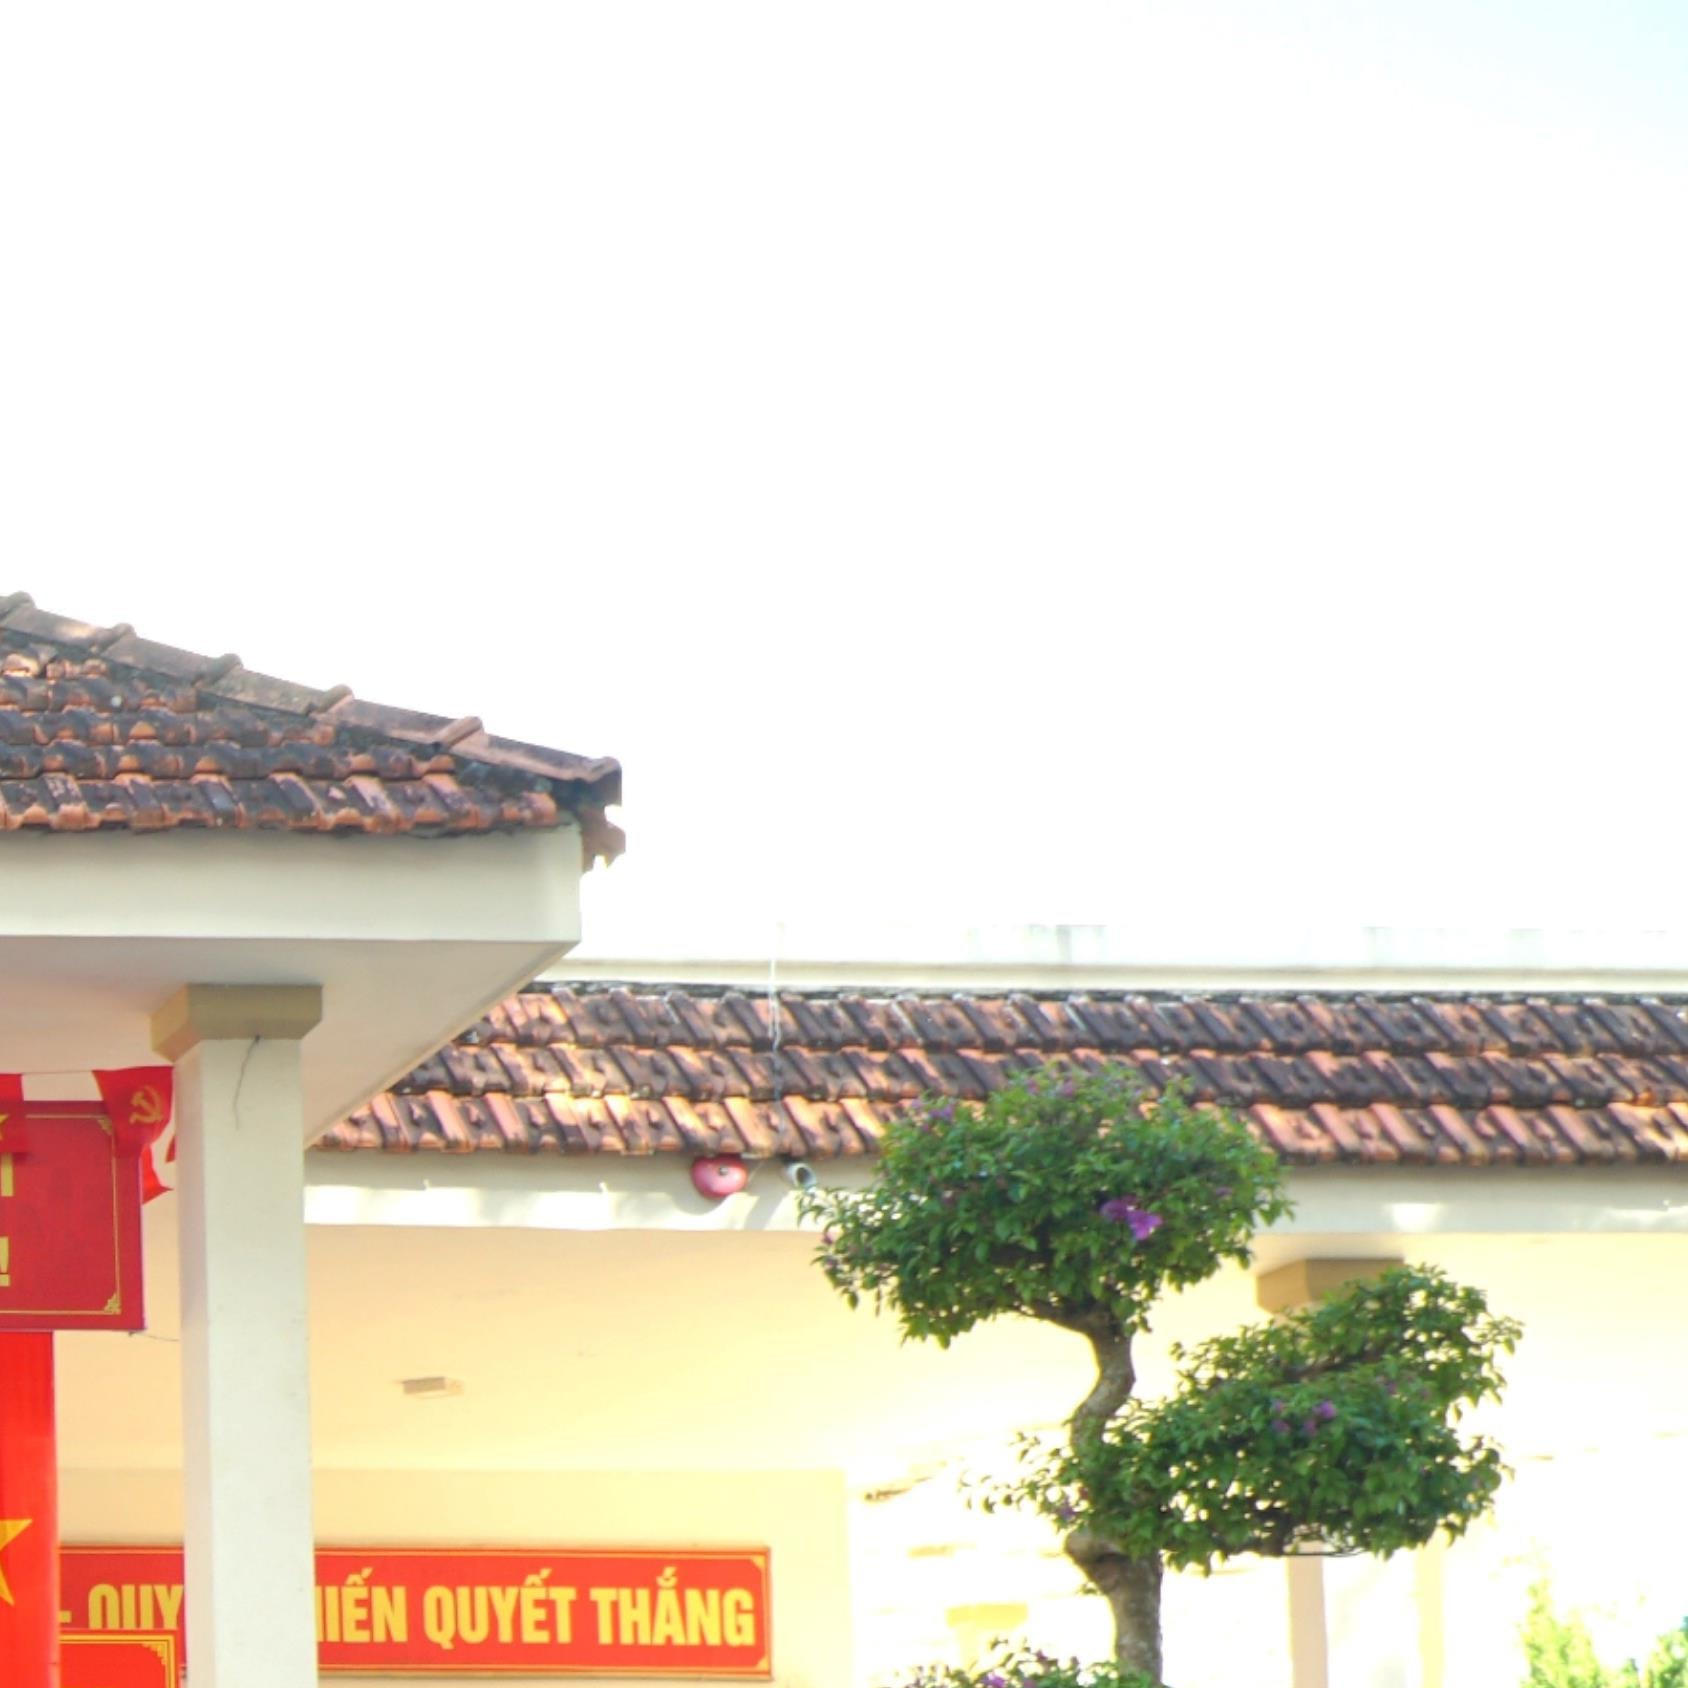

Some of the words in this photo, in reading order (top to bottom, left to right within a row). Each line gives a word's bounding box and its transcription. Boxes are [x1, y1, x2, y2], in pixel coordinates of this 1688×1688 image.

[316, 1567, 408, 1643] IẾN
[423, 1567, 577, 1650] QUYẾT
[589, 1566, 756, 1647] THẮNG
